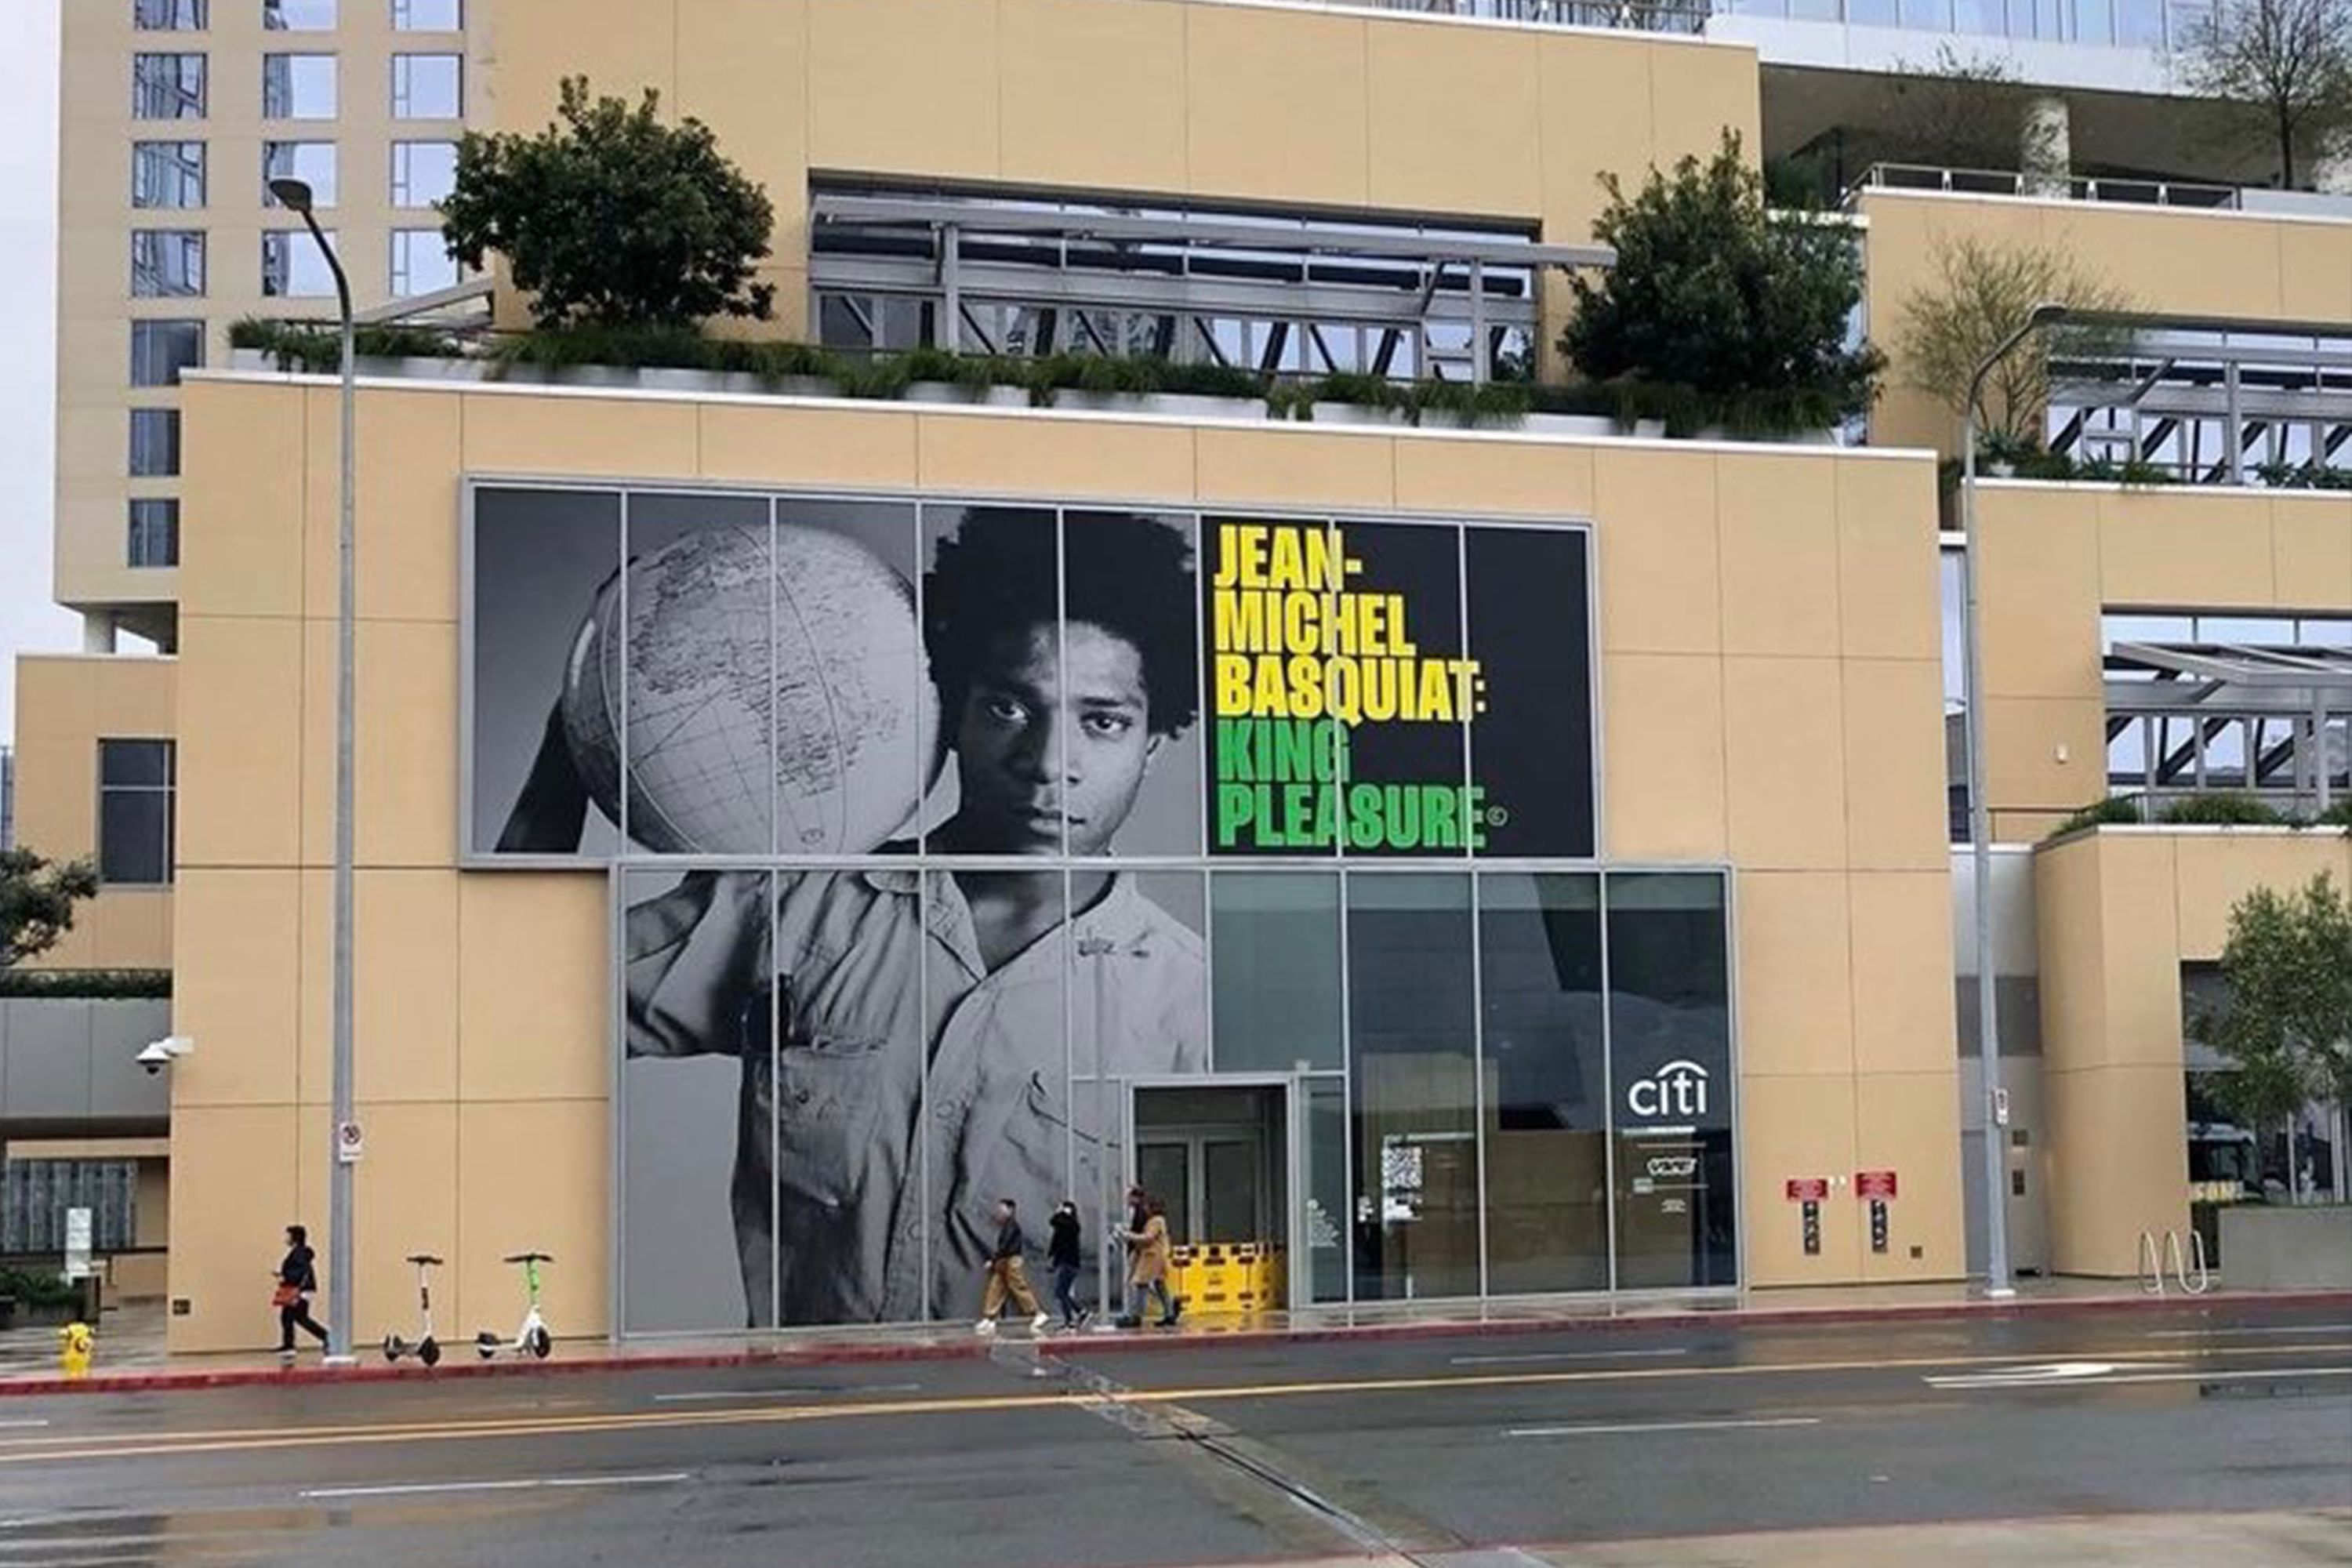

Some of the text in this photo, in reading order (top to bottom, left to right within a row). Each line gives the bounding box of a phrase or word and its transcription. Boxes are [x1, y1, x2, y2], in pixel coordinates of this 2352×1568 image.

[1214, 524, 1363, 590] JEAN-
[1214, 590, 1417, 656] MICHEL
[1216, 655, 1486, 728] BASQUIAT:
[1217, 718, 1350, 782] KING
[1219, 784, 1486, 849] PLEASURE
[1628, 1060, 1709, 1116] citi
